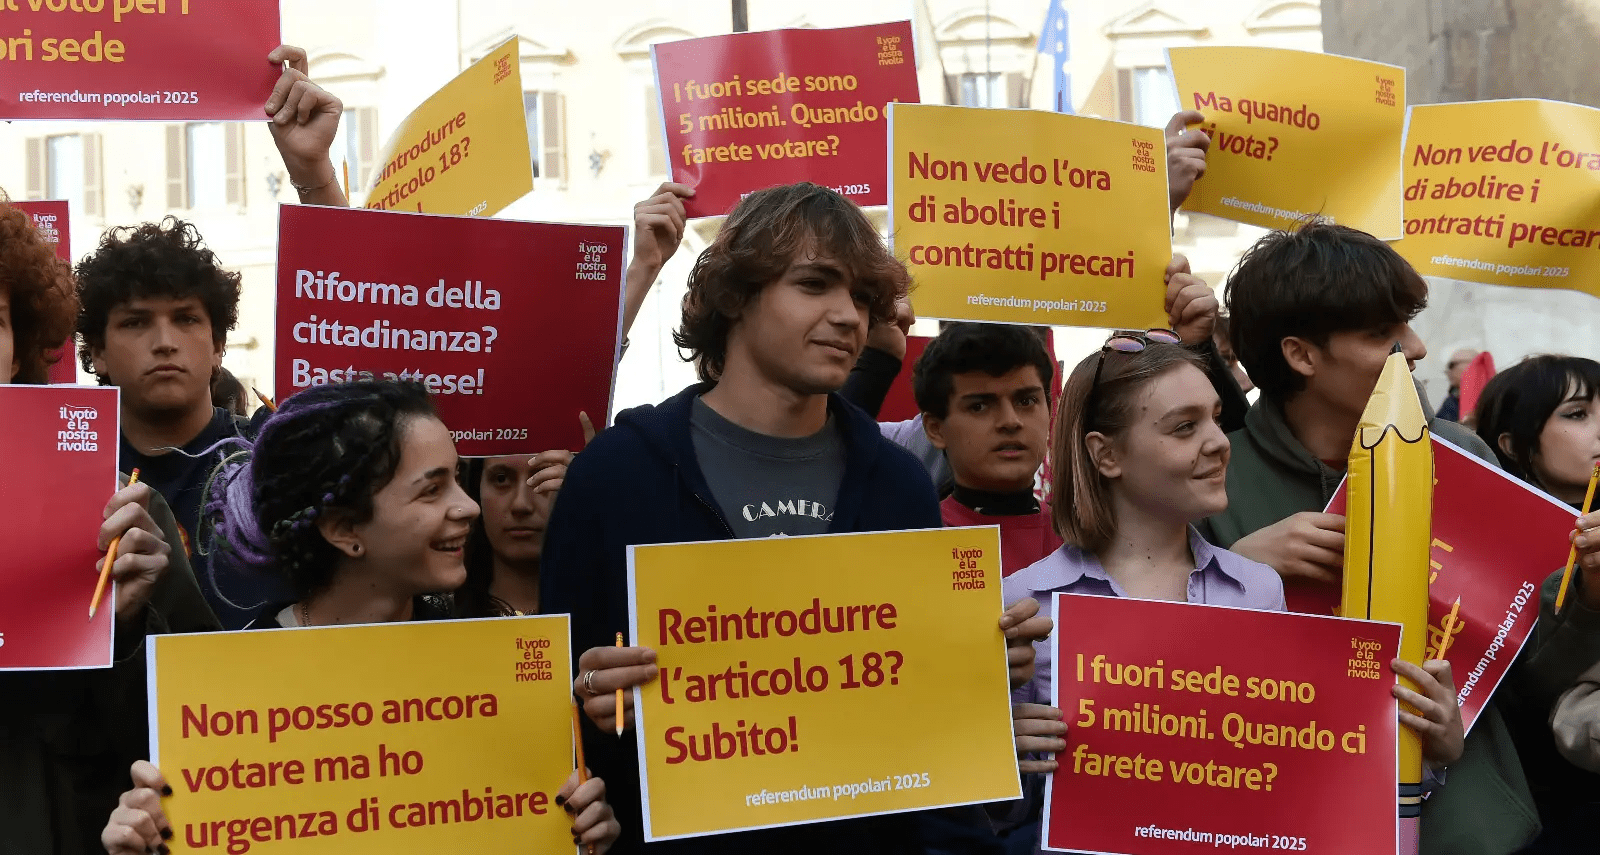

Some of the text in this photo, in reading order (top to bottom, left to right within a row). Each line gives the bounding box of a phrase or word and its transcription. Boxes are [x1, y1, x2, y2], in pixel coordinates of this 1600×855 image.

[41, 31, 126, 63] sede
[19, 89, 199, 106] referendum popolari 2025
[674, 72, 858, 102] I fuori sede sono
[680, 113, 693, 134] 5
[699, 105, 787, 131] milioni.
[791, 101, 878, 128] Quando
[1193, 91, 1321, 131] Ma quando
[438, 136, 471, 175] 18?
[681, 135, 840, 166] farete votare?
[1219, 132, 1279, 162] vota?
[1413, 143, 1462, 167] Non
[1468, 139, 1534, 164] vedo
[908, 152, 1111, 191] Non vedo l'ora
[1132, 155, 1155, 165] nostra
[844, 184, 871, 195] 2025
[1404, 175, 1541, 204] di abolire i
[908, 195, 1060, 229] di abolire i
[1220, 197, 1274, 215] referendum
[579, 242, 608, 253] il voto
[584, 251, 601, 262] è la
[576, 262, 607, 271] nostra
[909, 242, 1135, 280] contratti precari
[1431, 254, 1570, 277] referendum popolari 2025
[575, 270, 607, 281] rivolta
[295, 269, 501, 310] Riforma della
[967, 293, 1107, 313] referendum popolari 2025
[292, 315, 498, 352] cittadinanza?
[59, 406, 98, 420] il voto
[67, 418, 90, 430] è la
[57, 430, 98, 440] nostra
[57, 439, 98, 452] rivolta
[448, 428, 528, 443] opolari 2025
[951, 547, 983, 560] il voto
[959, 558, 977, 569] è la
[952, 569, 985, 581] nostra
[952, 579, 986, 591] rivolta
[658, 598, 898, 646] Reintrodurre
[1484, 610, 1518, 661] popolari
[1509, 580, 1535, 613] 2025
[515, 637, 551, 650] il voto
[523, 647, 544, 660] è la
[1350, 637, 1382, 651] il voto
[1356, 647, 1374, 660] è la
[515, 660, 552, 673] nostra
[1347, 668, 1381, 680] rivolta
[1348, 658, 1381, 669] nostra
[515, 669, 553, 683] rivolta
[659, 650, 904, 705] l'articolo 18?
[1076, 653, 1316, 704] I fuori sede sono
[181, 692, 499, 743] Non posso ancora
[1077, 698, 1367, 754] 5 milioni. Quando ci
[664, 716, 799, 764] Subito!
[181, 744, 424, 794] votare ma ho
[1072, 743, 1279, 792] farete votare?
[745, 772, 931, 807] referendum popolari 2025
[185, 788, 549, 855] urgenza di cambiare
[1134, 824, 1308, 851] referendum popolari 2025
